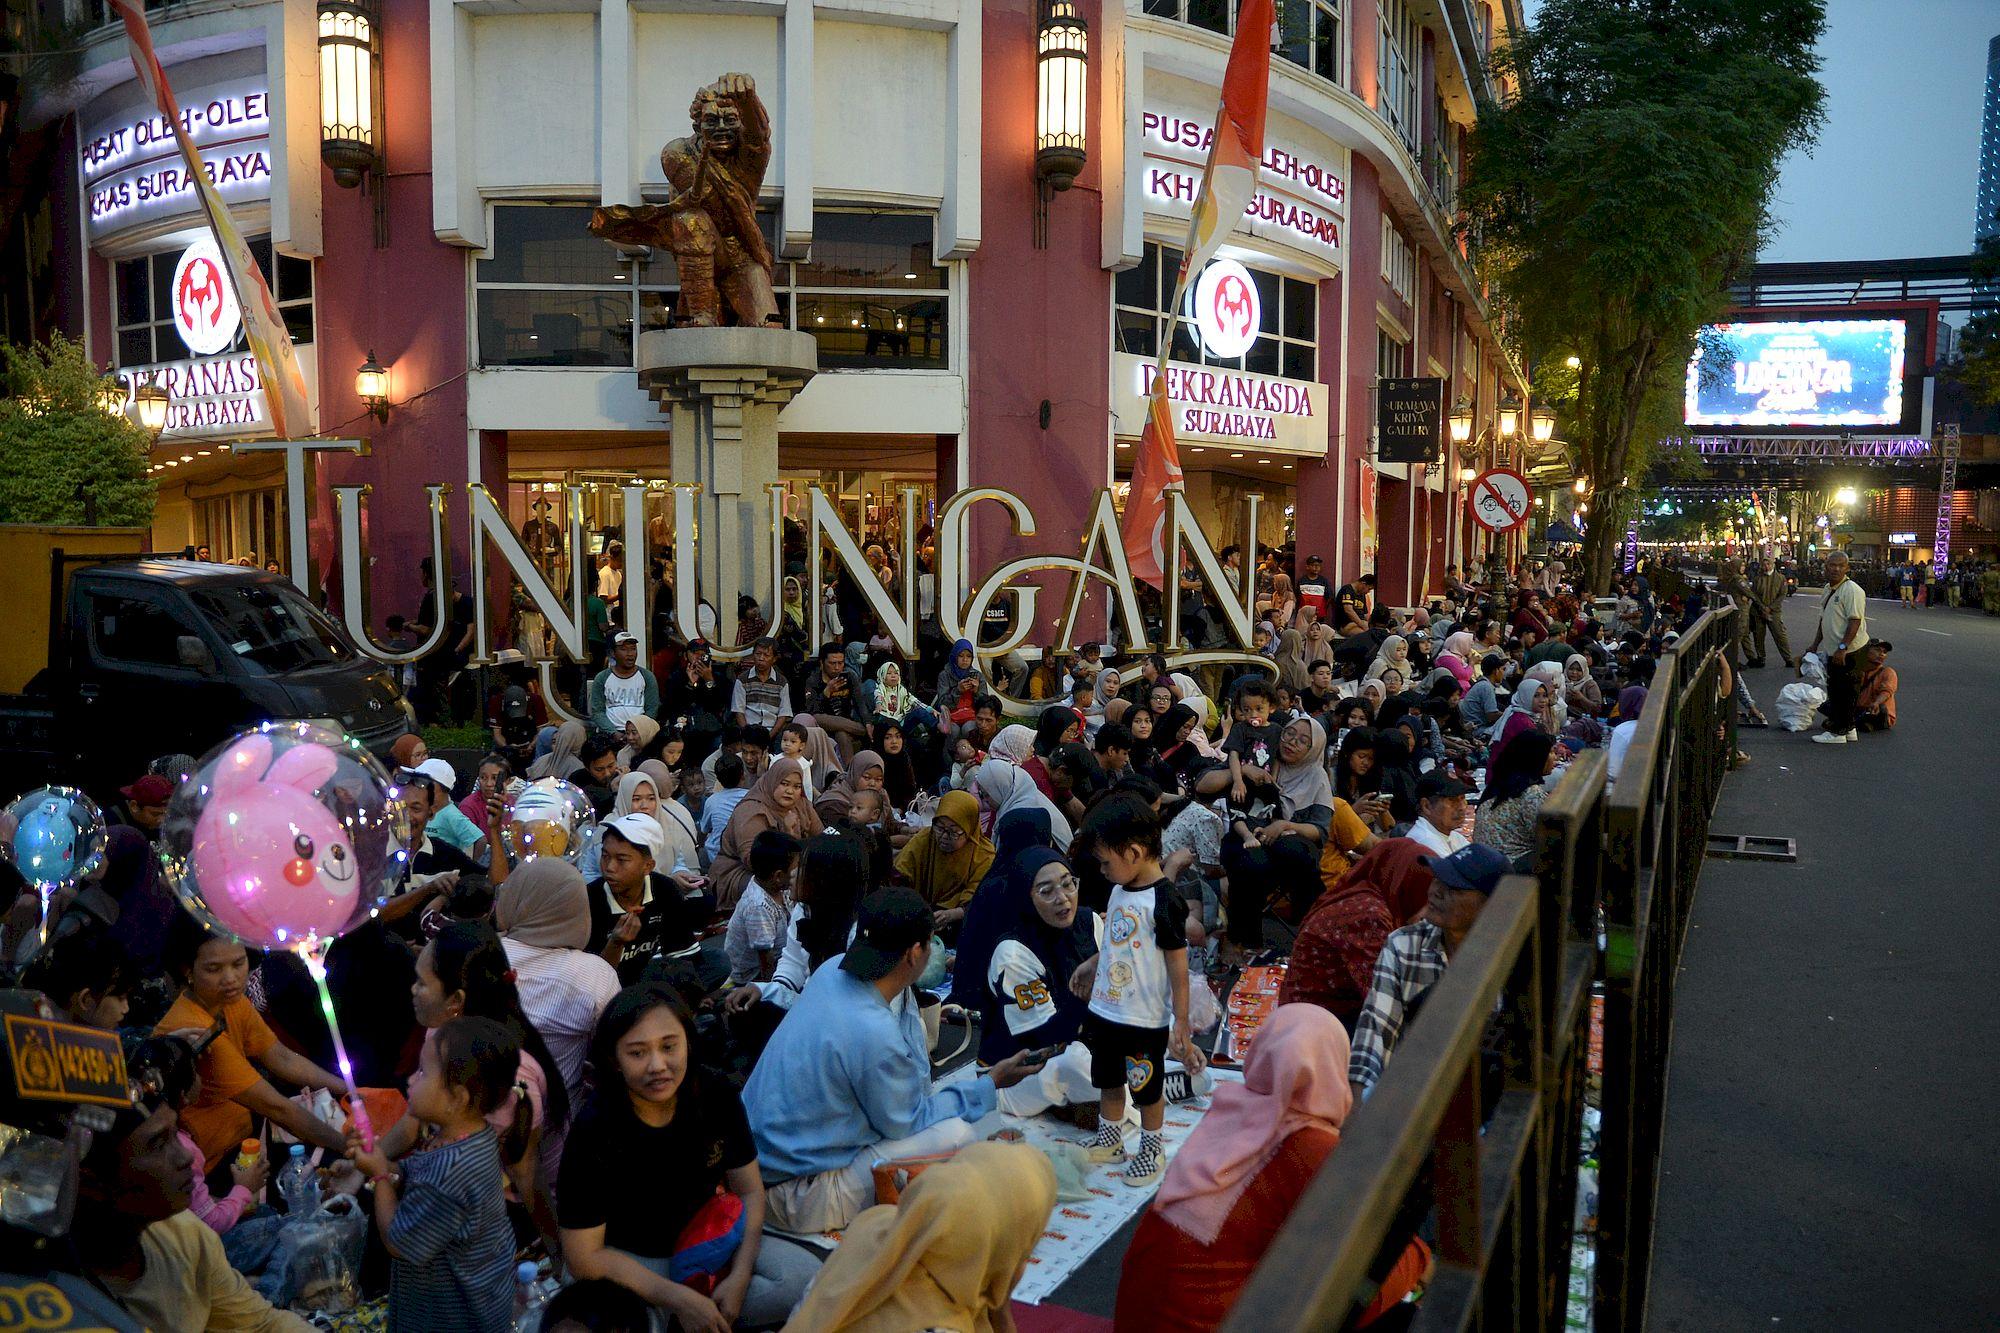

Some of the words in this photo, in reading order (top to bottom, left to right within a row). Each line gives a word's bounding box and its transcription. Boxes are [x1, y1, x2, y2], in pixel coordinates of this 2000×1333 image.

[82, 127, 128, 165] PUSAT
[134, 92, 269, 146] OLEH-OLE
[1143, 111, 1215, 152] PUSA
[1261, 148, 1345, 204] LEH-OLEH
[89, 182, 130, 217] KHAS
[1245, 194, 1340, 248] SURABAYA
[1142, 364, 1313, 417] DEKRANASDA
[164, 398, 256, 429] URABAYA
[1185, 408, 1277, 439] SURABAYA
[1386, 425, 1430, 436] GALLERY
[1394, 412, 1425, 423] KRIYA
[1013, 977, 1050, 1010] 65
